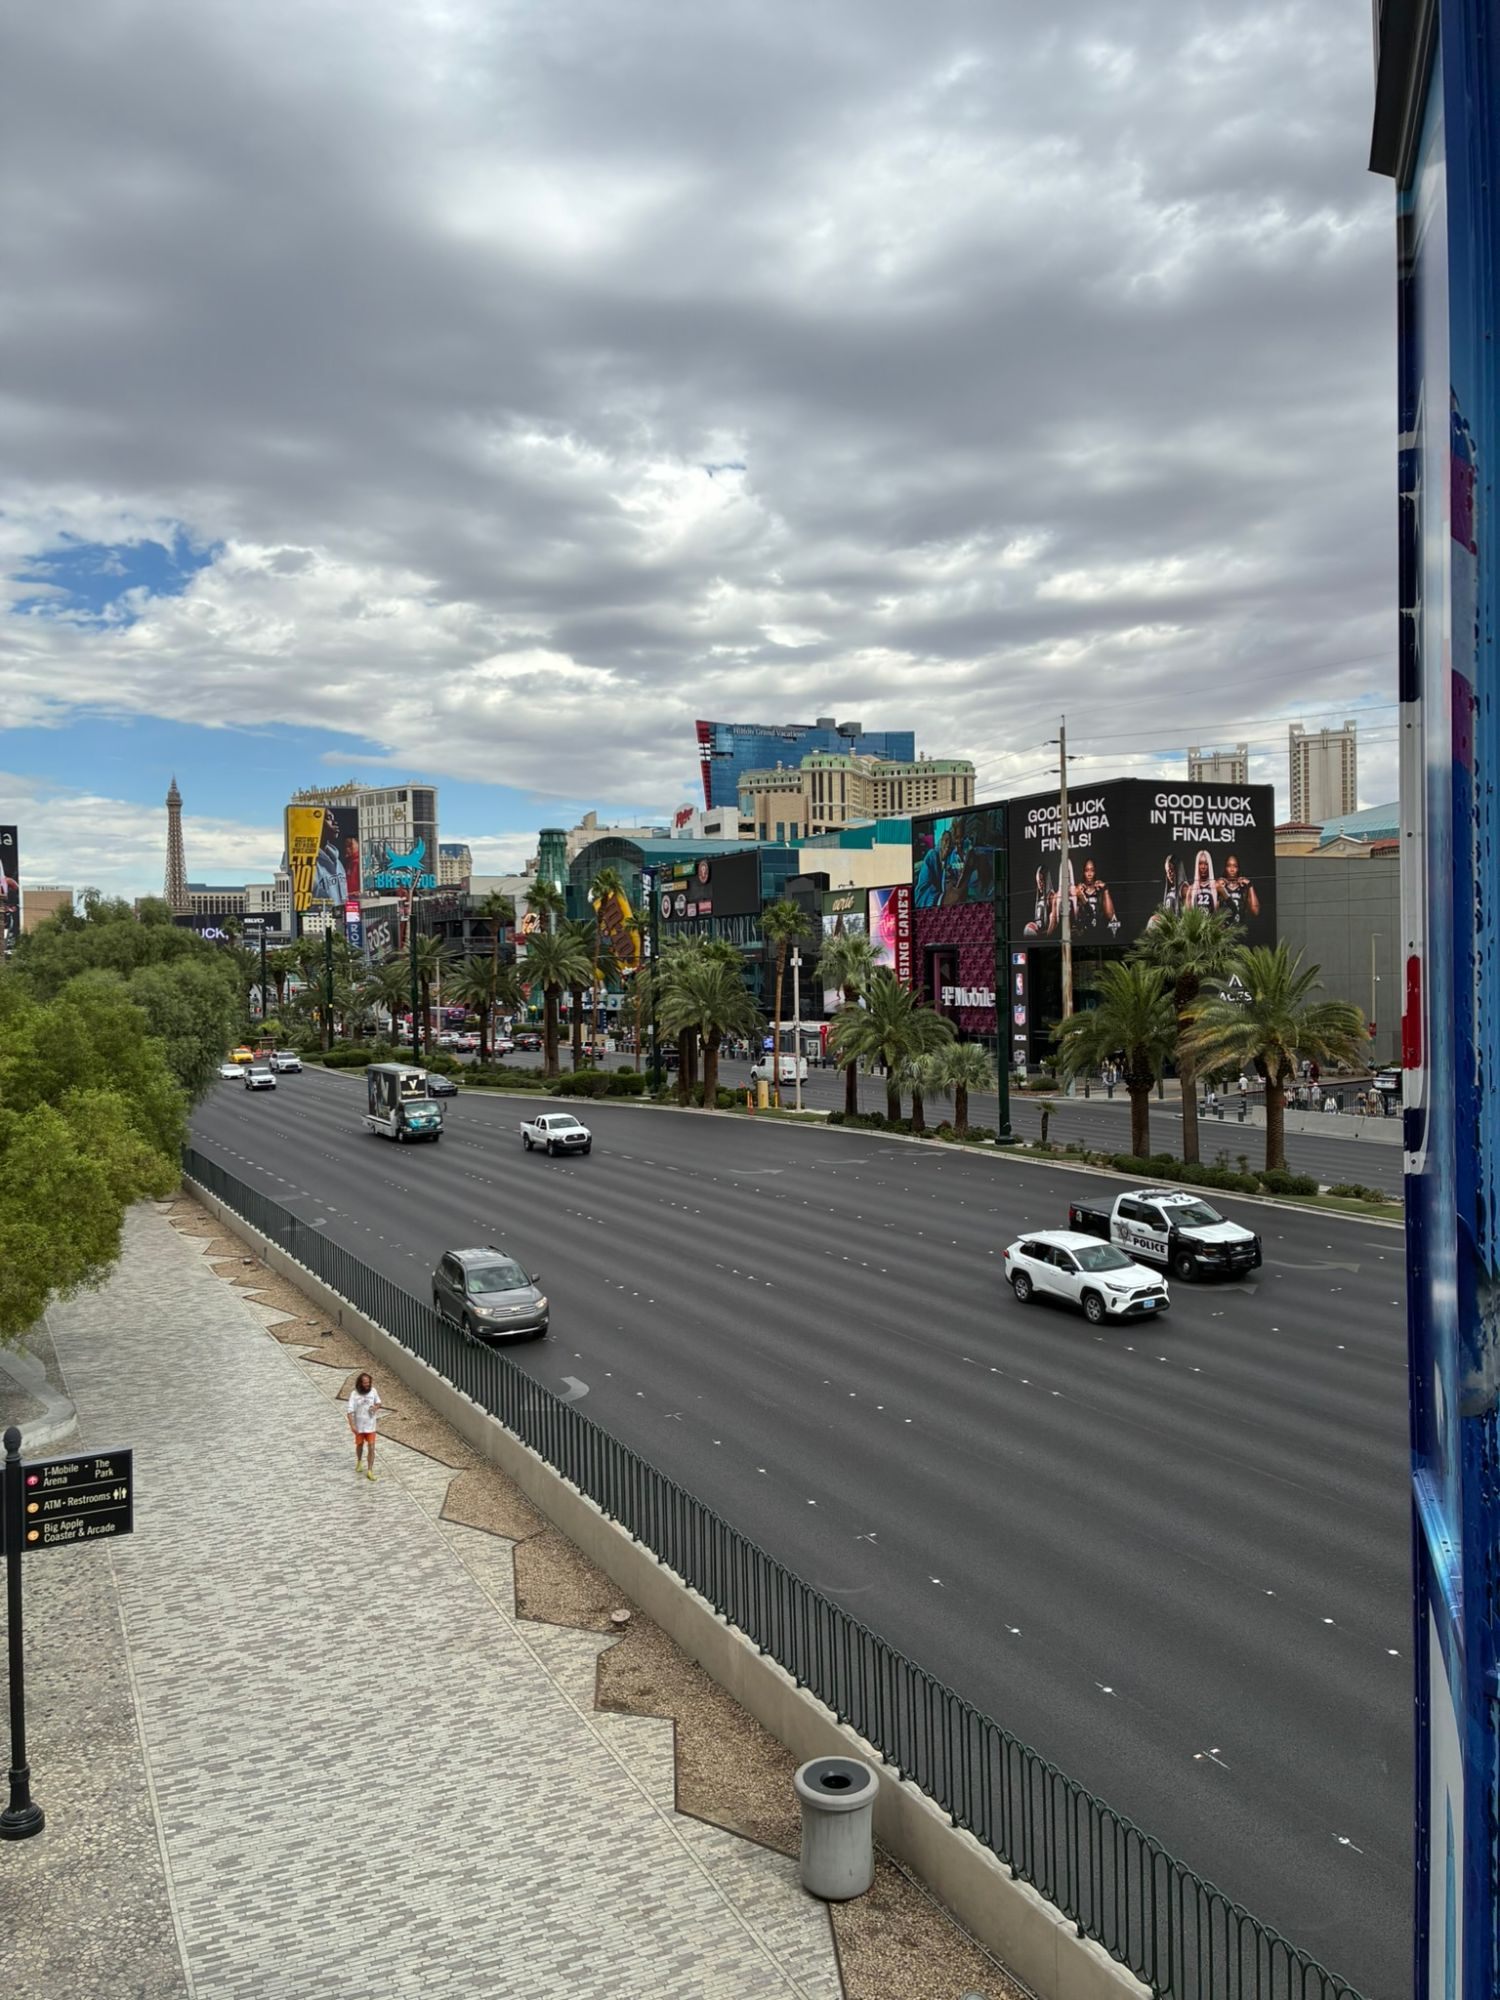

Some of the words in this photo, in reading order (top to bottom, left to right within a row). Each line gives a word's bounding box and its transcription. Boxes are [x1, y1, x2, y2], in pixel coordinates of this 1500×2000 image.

[733, 726, 754, 736] Hilton
[1068, 797, 1106, 817] LUCK
[1155, 793, 1204, 809] GOOD
[1208, 795, 1252, 811] LUCK
[1150, 809, 1166, 825] IN
[1170, 810, 1204, 826] THE
[1206, 812, 1257, 827] WNBA
[1024, 825, 1037, 839] IN
[1039, 821, 1062, 837] THE
[1068, 813, 1110, 833] WNBA
[1173, 827, 1236, 842] FINALS!
[1041, 833, 1092, 853] FINLS!
[377, 874, 437, 888] BREWOG
[1197, 894, 1210, 905] 22
[898, 889, 909, 937] CANE'S
[1133, 1237, 1165, 1253] POLICE
[43, 1464, 79, 1477] T-Mobile
[95, 1459, 110, 1468] The
[95, 1468, 114, 1479] Park
[43, 1476, 68, 1487] Arena
[43, 1499, 61, 1510] ATM
[68, 1492, 111, 1506] Restrooms
[44, 1523, 59, 1533] Big
[60, 1519, 84, 1530] Apple
[44, 1530, 76, 1543] Coaster
[78, 1527, 85, 1537] &
[87, 1524, 115, 1535] Arcade
